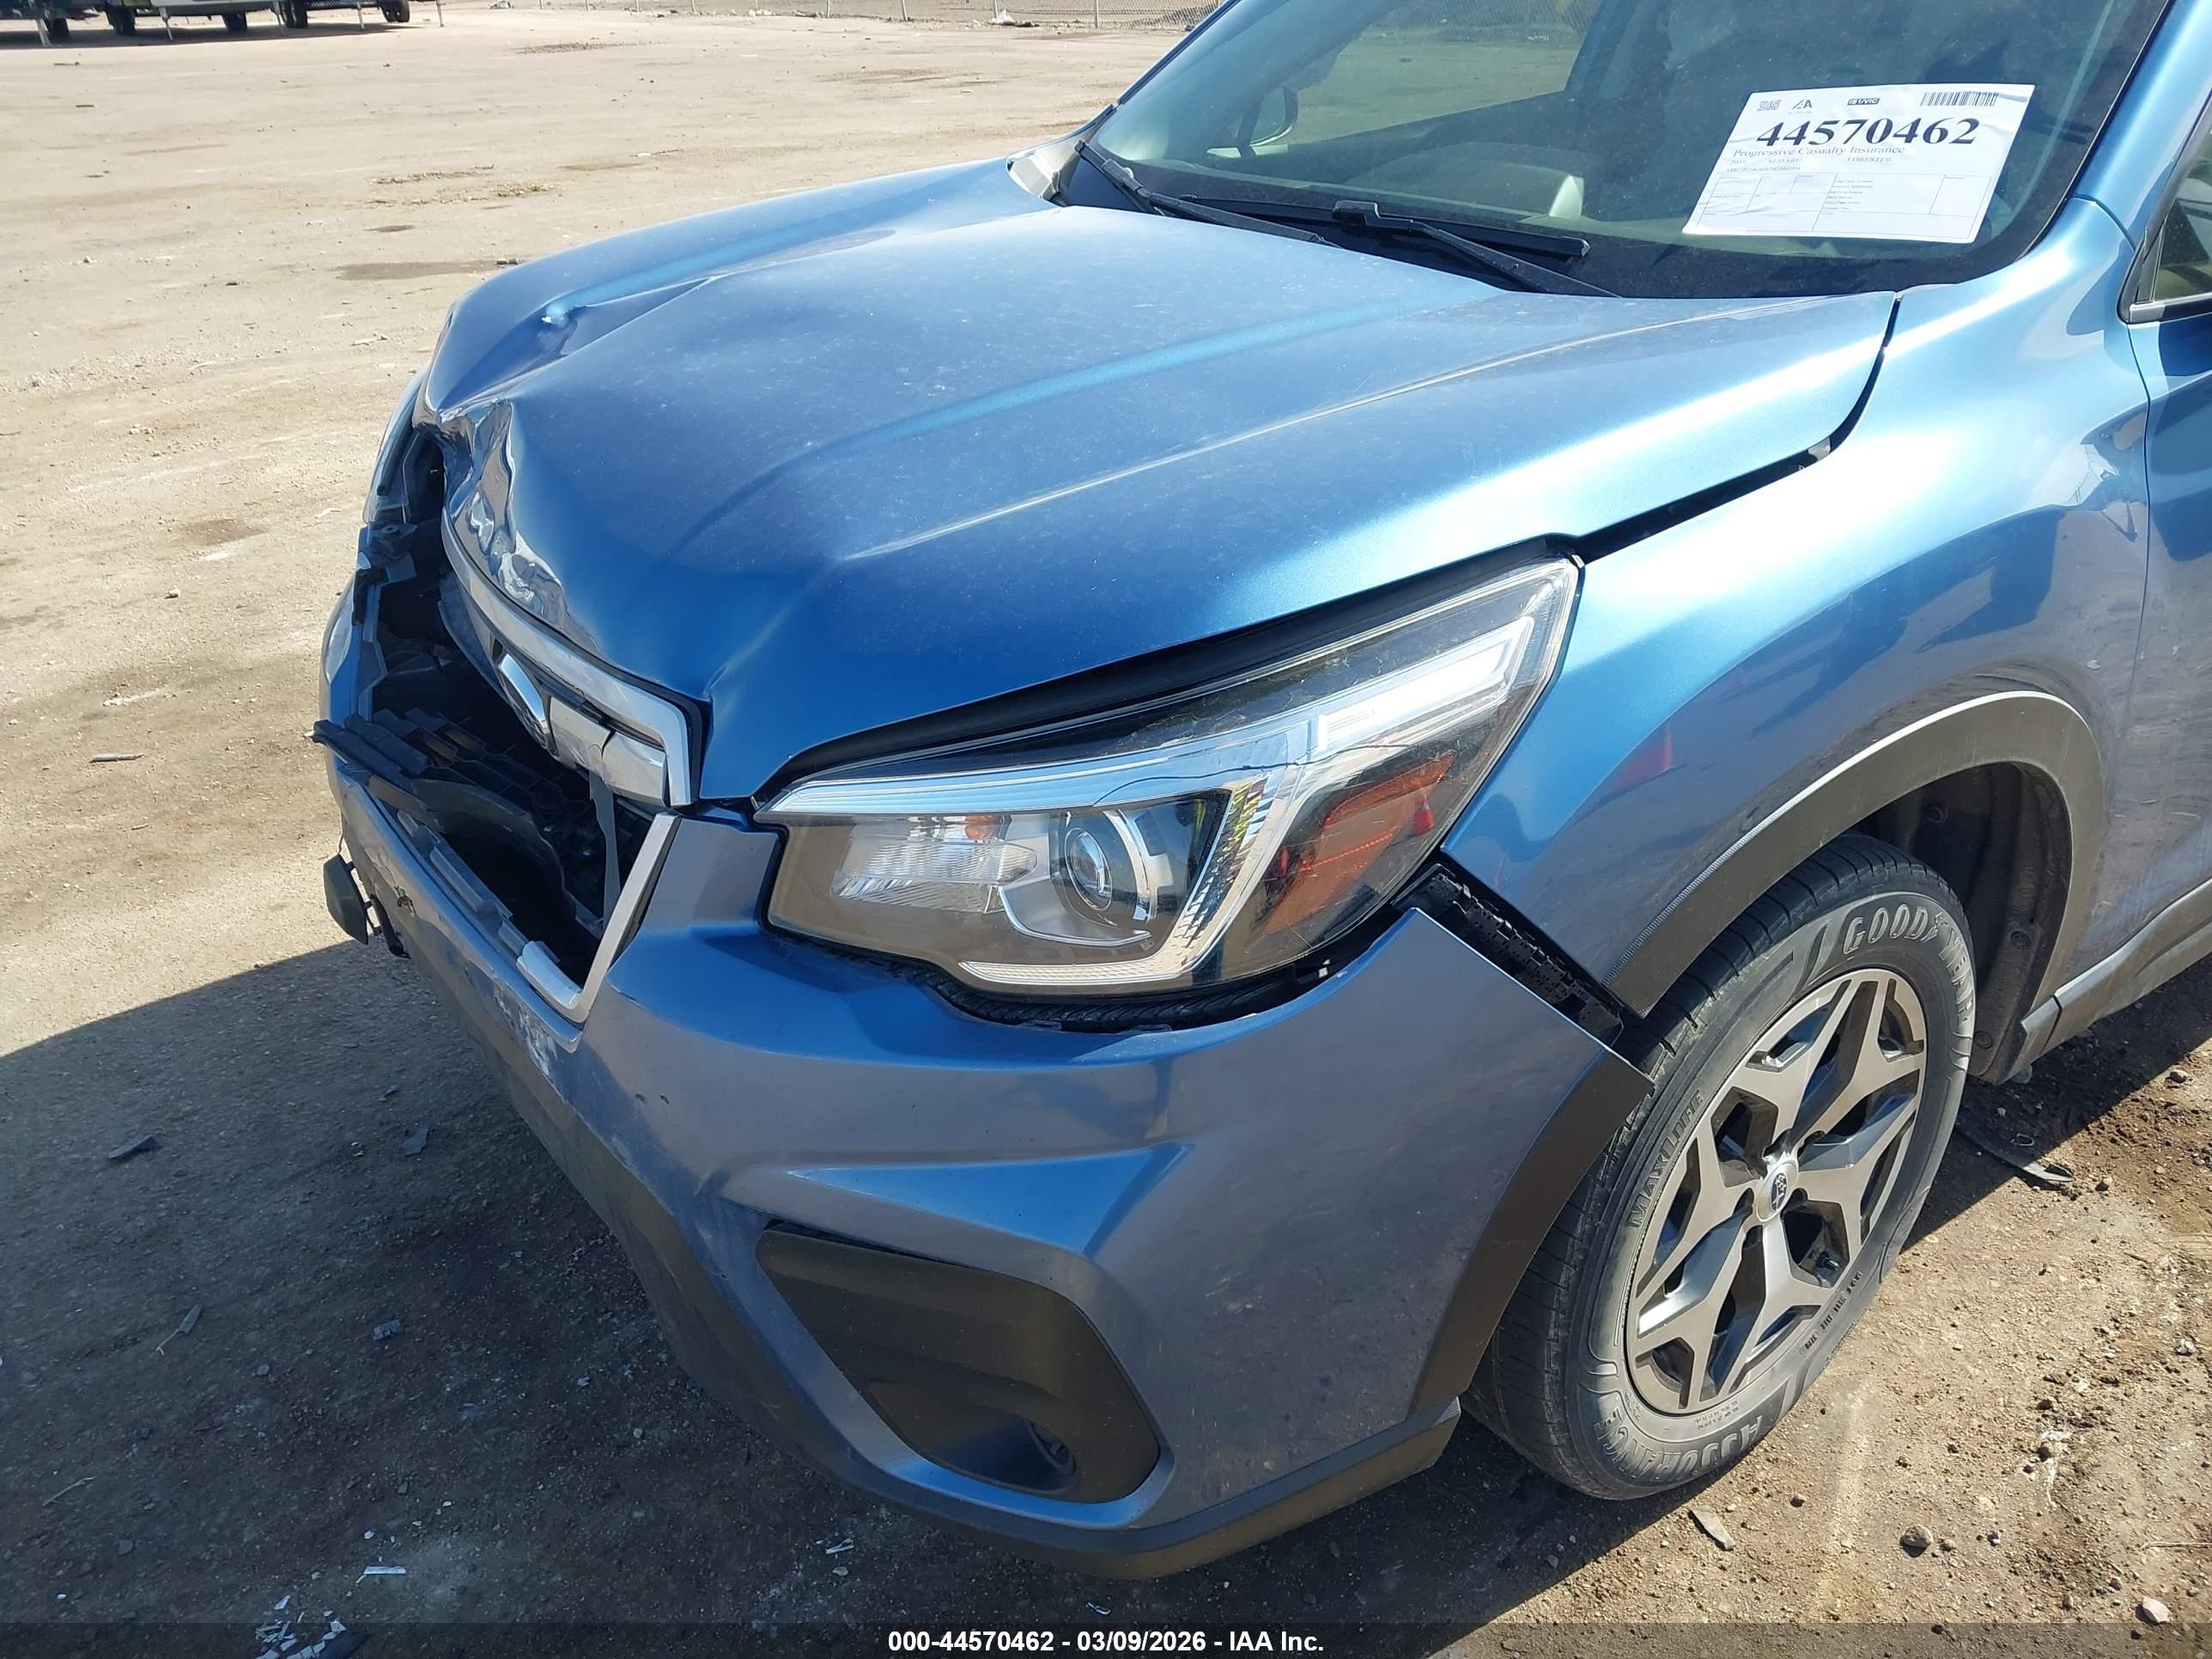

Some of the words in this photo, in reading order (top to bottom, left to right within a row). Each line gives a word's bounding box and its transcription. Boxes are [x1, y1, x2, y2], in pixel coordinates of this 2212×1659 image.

[1756, 118, 1980, 146] 44570462
[1733, 149, 1795, 158] Progressive
[1798, 146, 1846, 156] Casualty
